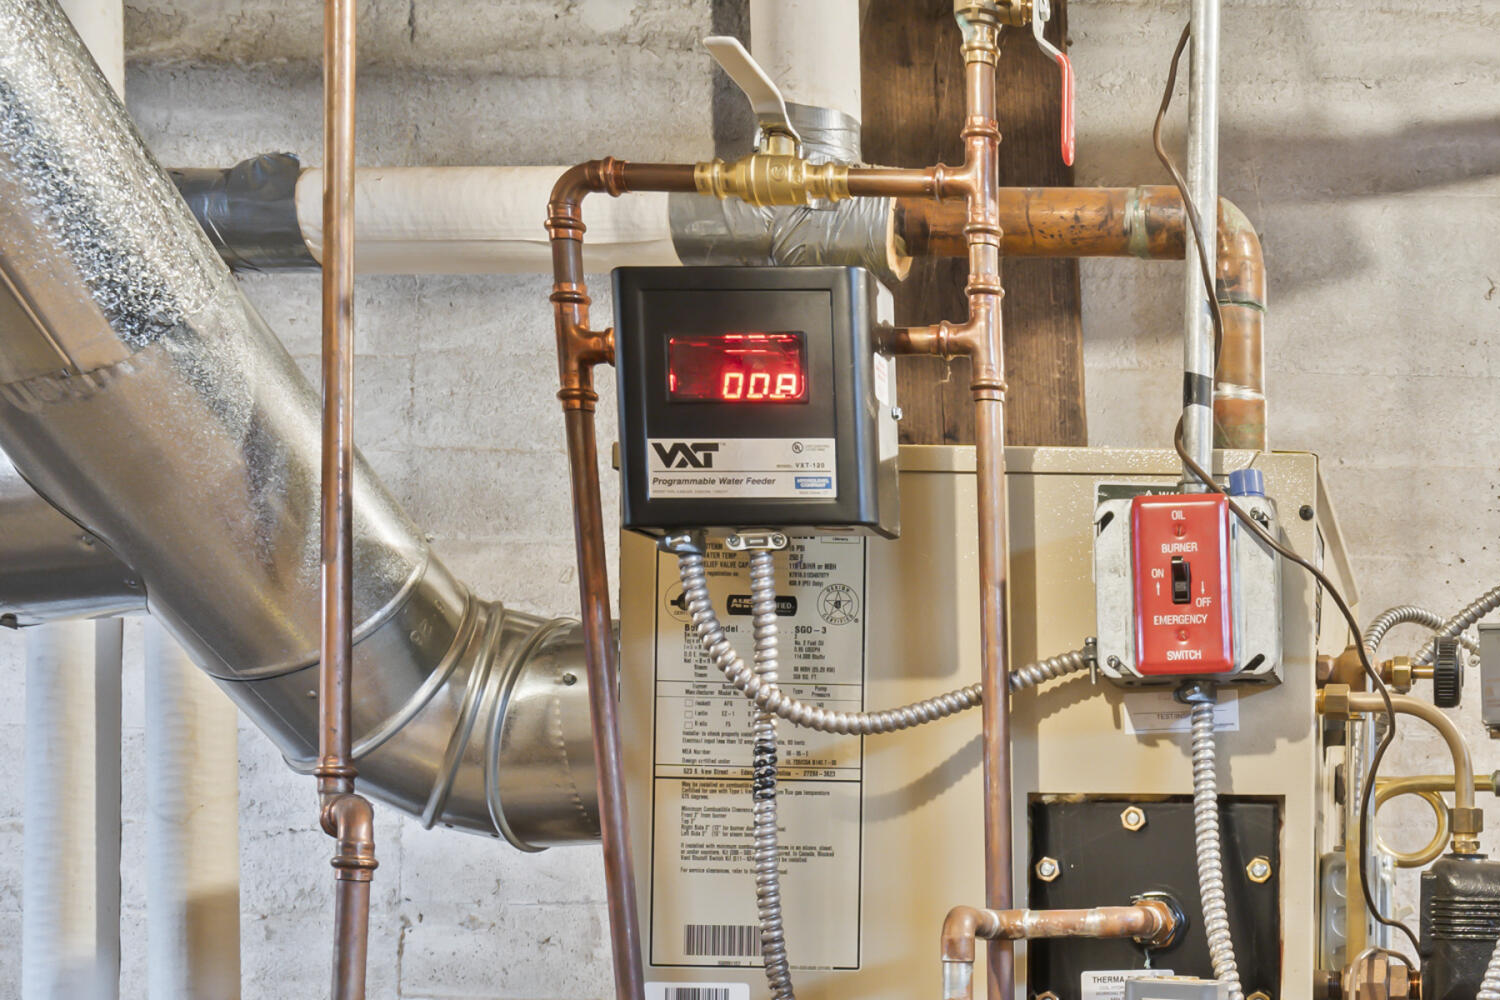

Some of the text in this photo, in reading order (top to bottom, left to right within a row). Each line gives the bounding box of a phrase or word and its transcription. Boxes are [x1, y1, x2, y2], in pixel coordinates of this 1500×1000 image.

[651, 442, 719, 468] VXT
[652, 477, 776, 487] Programmable Water Feeder
[1171, 510, 1186, 520] OIL
[1161, 542, 1198, 553] BURNER
[1151, 568, 1164, 578] ON
[1195, 597, 1212, 607] OFF
[1153, 614, 1208, 625] EMERGENCY
[1166, 650, 1202, 661] SWITCH
